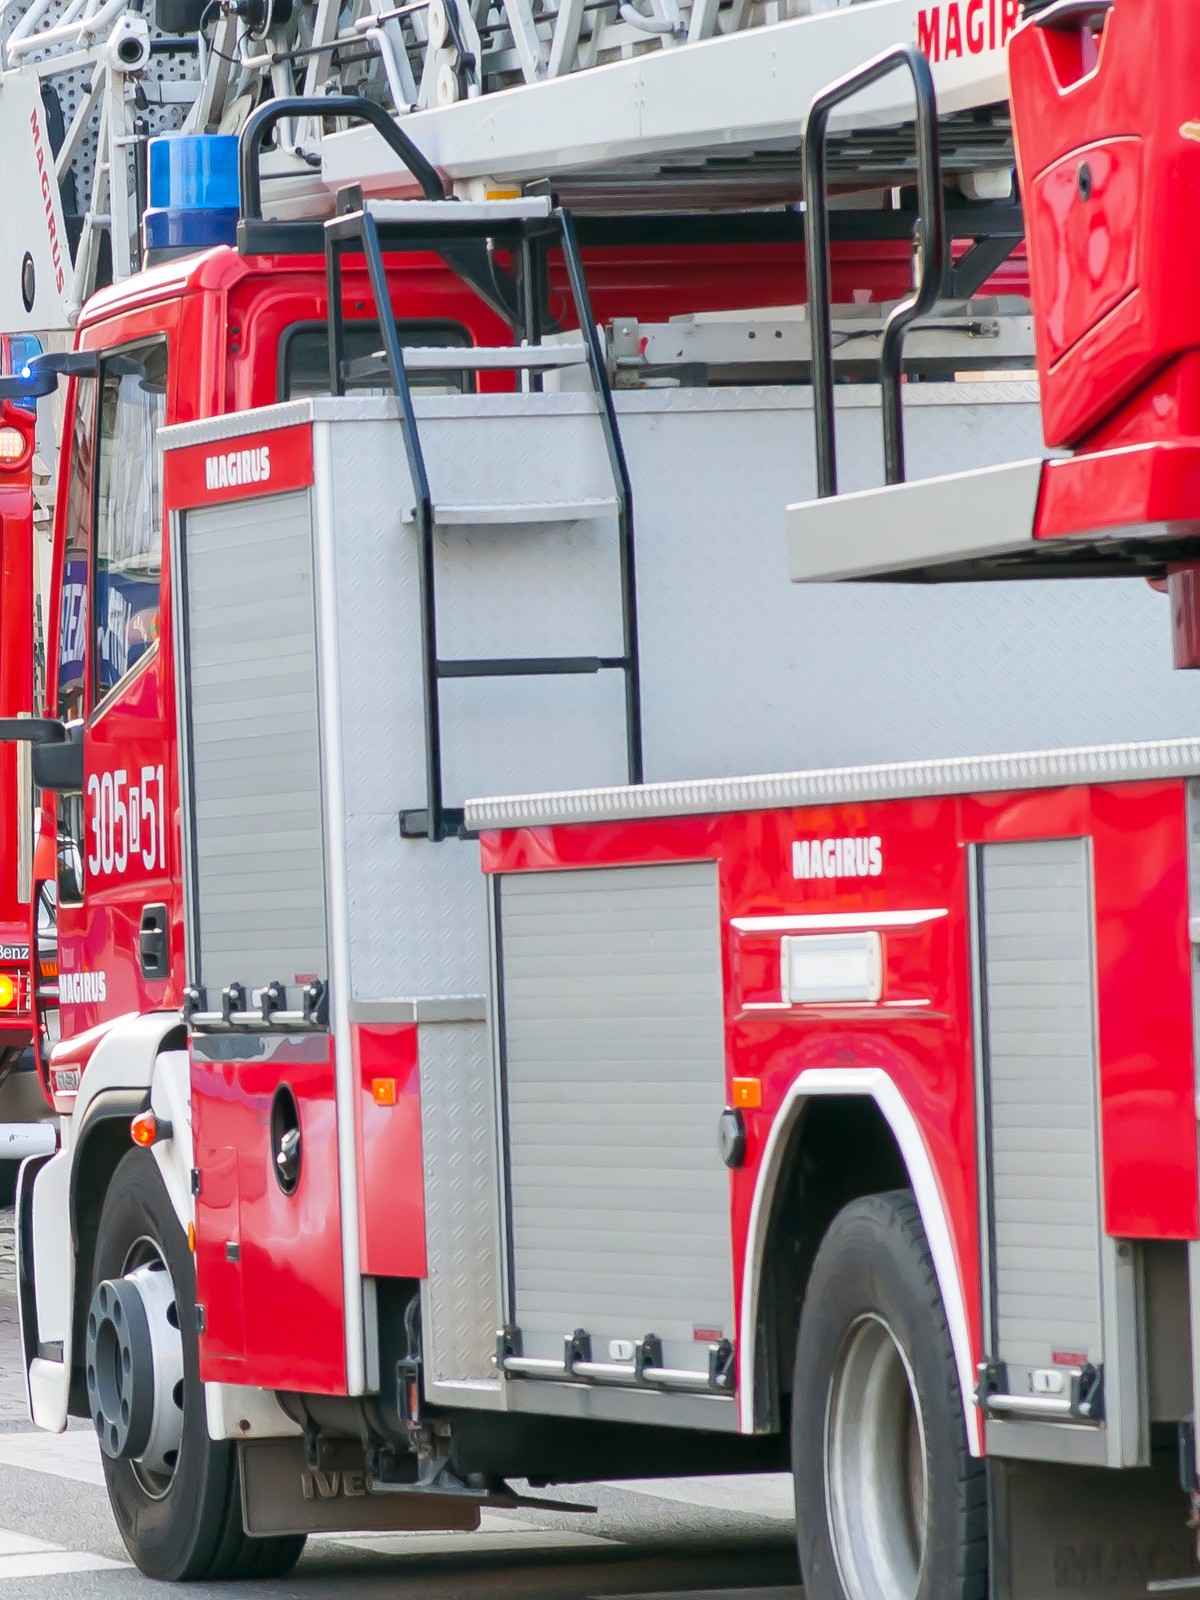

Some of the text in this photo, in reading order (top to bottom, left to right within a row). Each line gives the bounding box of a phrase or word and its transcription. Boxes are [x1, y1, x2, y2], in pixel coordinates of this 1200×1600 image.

[29, 105, 65, 295] MAGIRUS
[205, 446, 271, 490] MAGIRUS
[792, 836, 883, 879] MAGIRUS
[58, 971, 107, 1004] MAGIRUS
